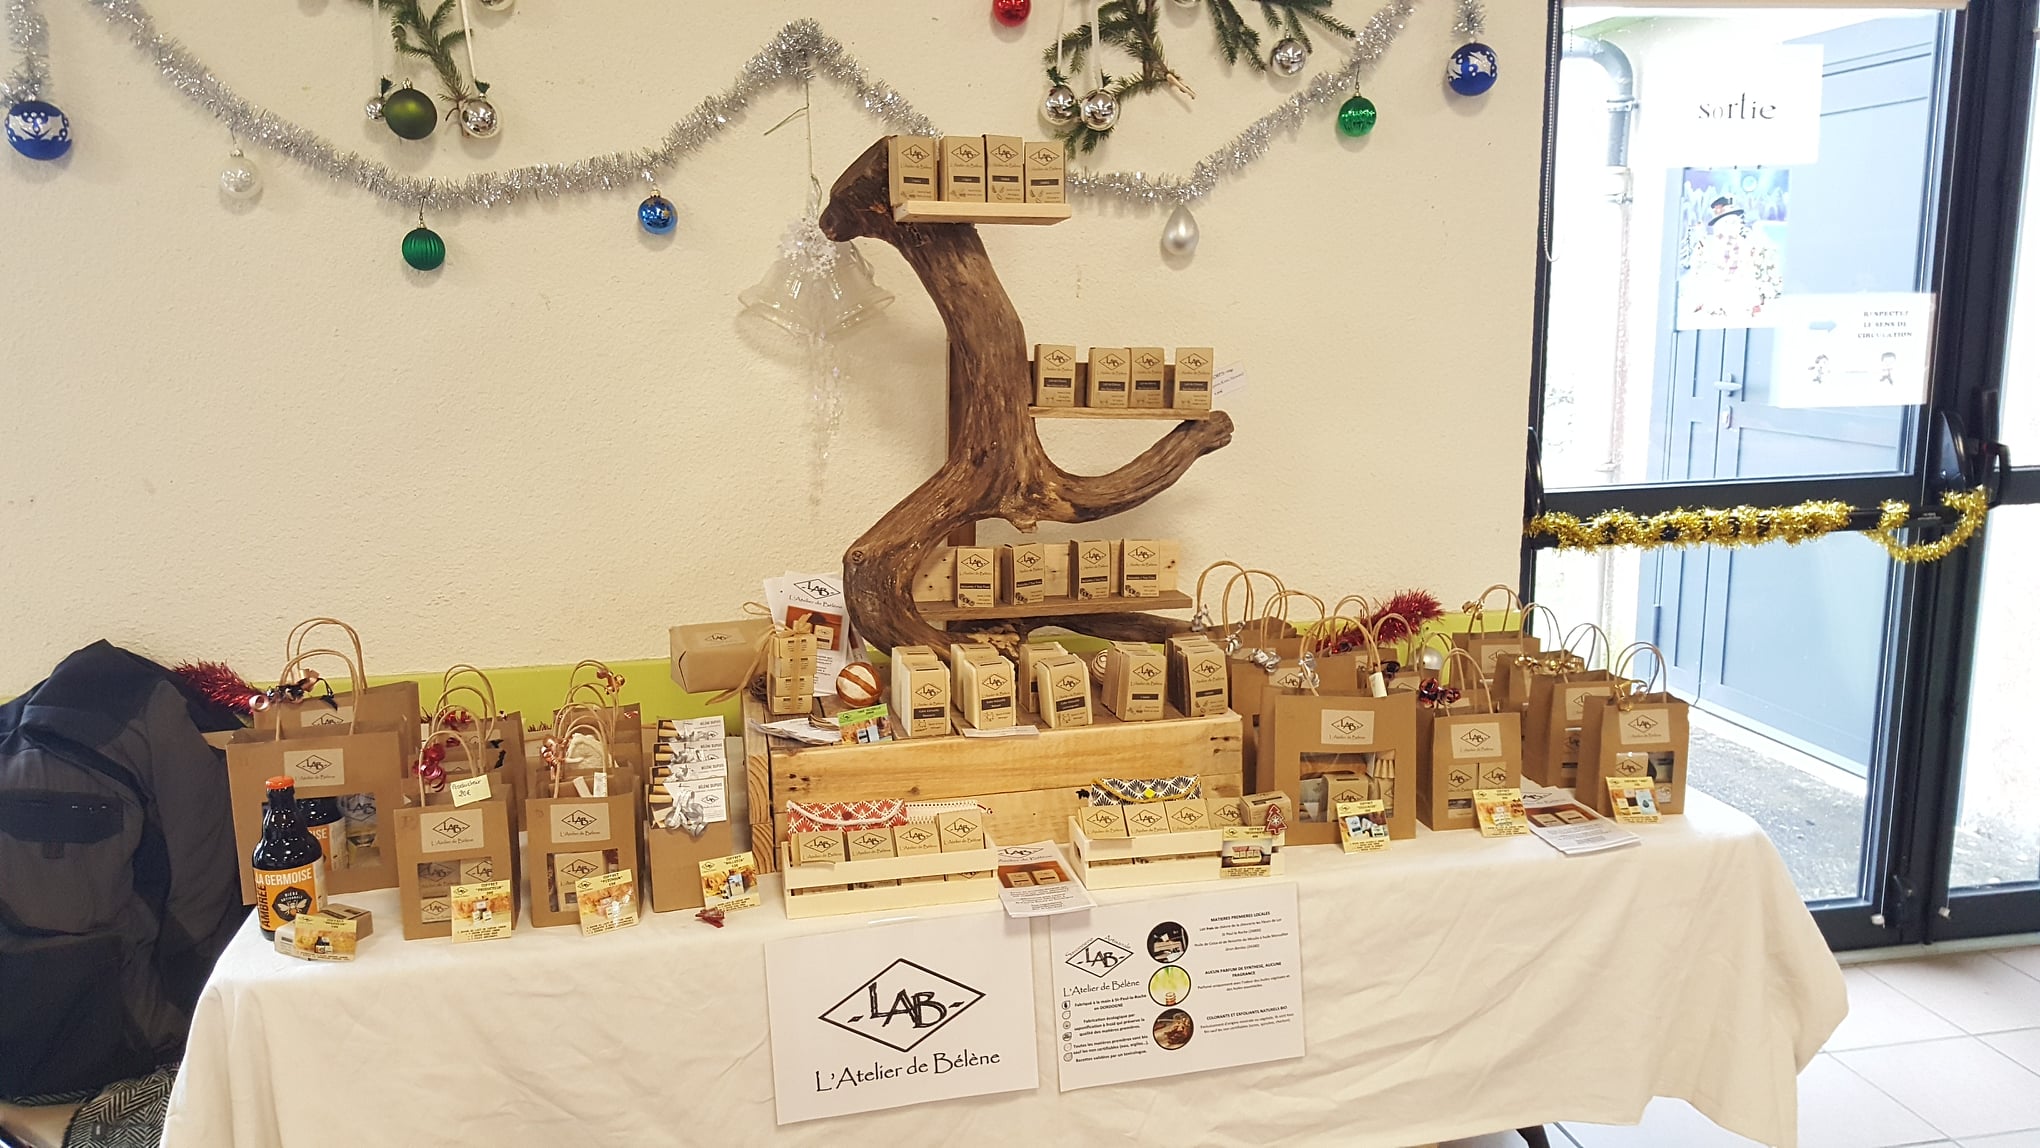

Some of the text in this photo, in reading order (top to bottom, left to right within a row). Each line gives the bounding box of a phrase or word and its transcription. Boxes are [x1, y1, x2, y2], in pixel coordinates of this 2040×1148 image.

[808, 581, 829, 597] LAB
[1341, 719, 1356, 731] LAB
[1637, 718, 1651, 729] LAB
[1469, 732, 1483, 742] LAB
[306, 759, 323, 770] LAB
[1621, 762, 1636, 773] LAB
[571, 814, 589, 825] LAB
[1095, 813, 1112, 824] LAB
[1139, 813, 1155, 823] LAB
[1180, 810, 1197, 822] LAB
[443, 821, 461, 833] LAB
[954, 822, 970, 833] LAB
[862, 836, 880, 845] LAB
[909, 831, 926, 840] LAB
[813, 840, 831, 848] LAB
[571, 863, 589, 874] LAB
[255, 868, 312, 886] LA GERMOISE
[1086, 948, 1118, 967] LAB
[1064, 979, 1140, 997] L'Atelier de Bélène
[868, 982, 947, 1028] LAB
[816, 1049, 1001, 1092] L'Atelier de Bélène
